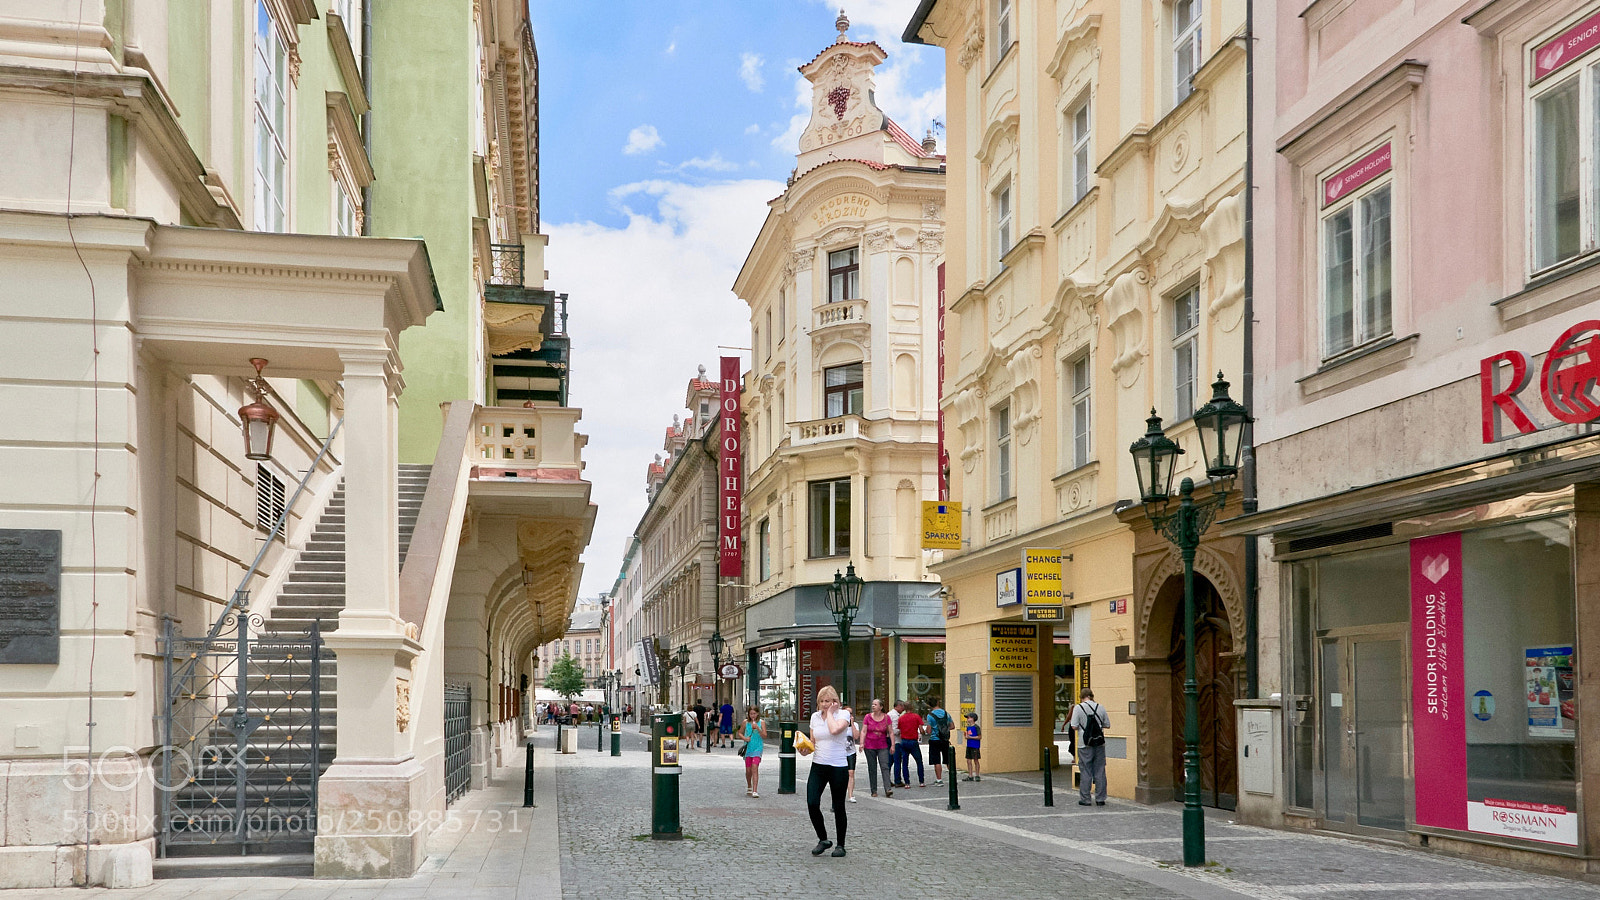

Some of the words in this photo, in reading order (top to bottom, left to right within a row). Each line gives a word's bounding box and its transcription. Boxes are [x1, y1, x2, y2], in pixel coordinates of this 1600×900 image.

[1568, 25, 1598, 49] SENIOR
[1344, 168, 1365, 184] SENIOR
[1364, 151, 1391, 172] HOLDING
[723, 378, 738, 550] DOROTHEUM
[925, 531, 960, 541] SPARKYS
[1026, 555, 1062, 564] CHANGE
[1027, 590, 1062, 598] CAMBIO
[1425, 594, 1437, 658] HOLDING
[802, 651, 812, 718] DOROTHEUM
[1427, 662, 1438, 714] SENIOR
[1492, 810, 1557, 828] ROSSMANN
